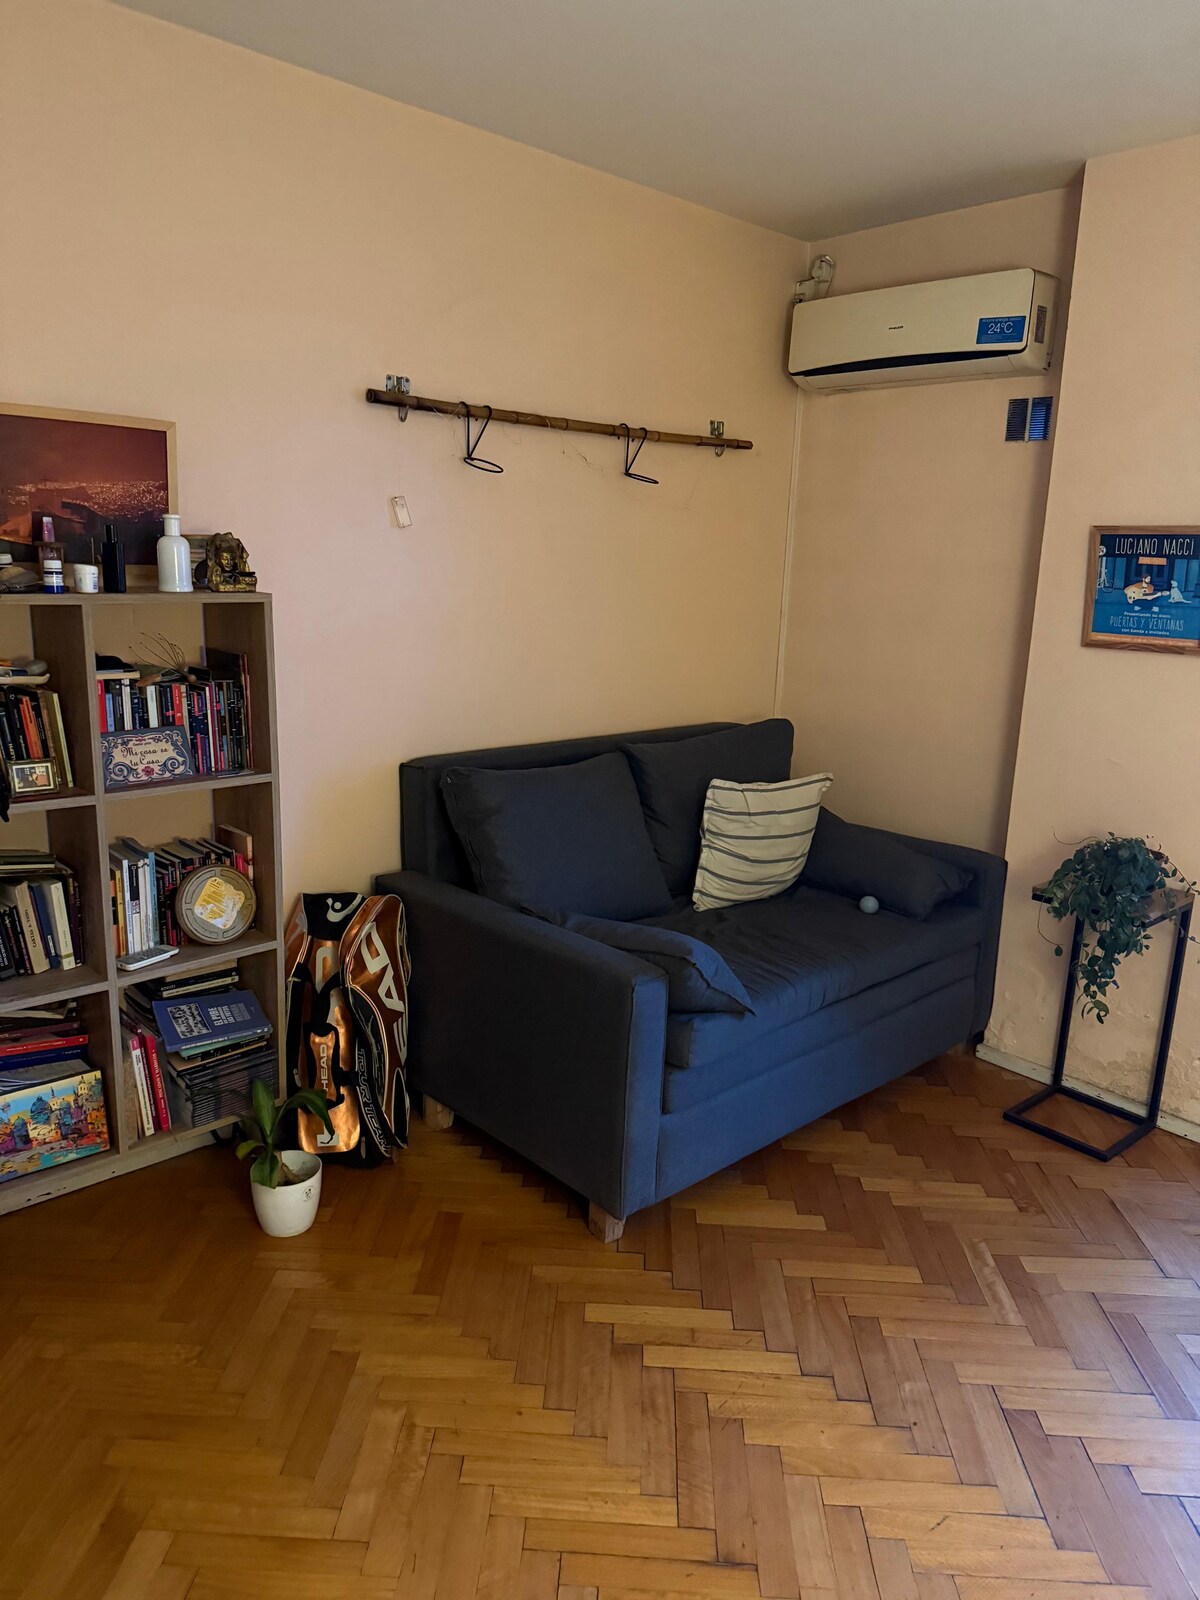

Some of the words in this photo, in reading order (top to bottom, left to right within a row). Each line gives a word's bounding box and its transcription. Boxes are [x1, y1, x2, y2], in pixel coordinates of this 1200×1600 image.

[1115, 537, 1158, 555] LUCIANO
[1162, 539, 1194, 556] NACCI
[1109, 615, 1138, 628] PUERTAS
[1140, 617, 1146, 628] Y
[1149, 618, 1184, 631] VENTANAS
[130, 759, 139, 767] tu
[320, 1044, 328, 1092] HEAD
[358, 1048, 373, 1103] TOUR
